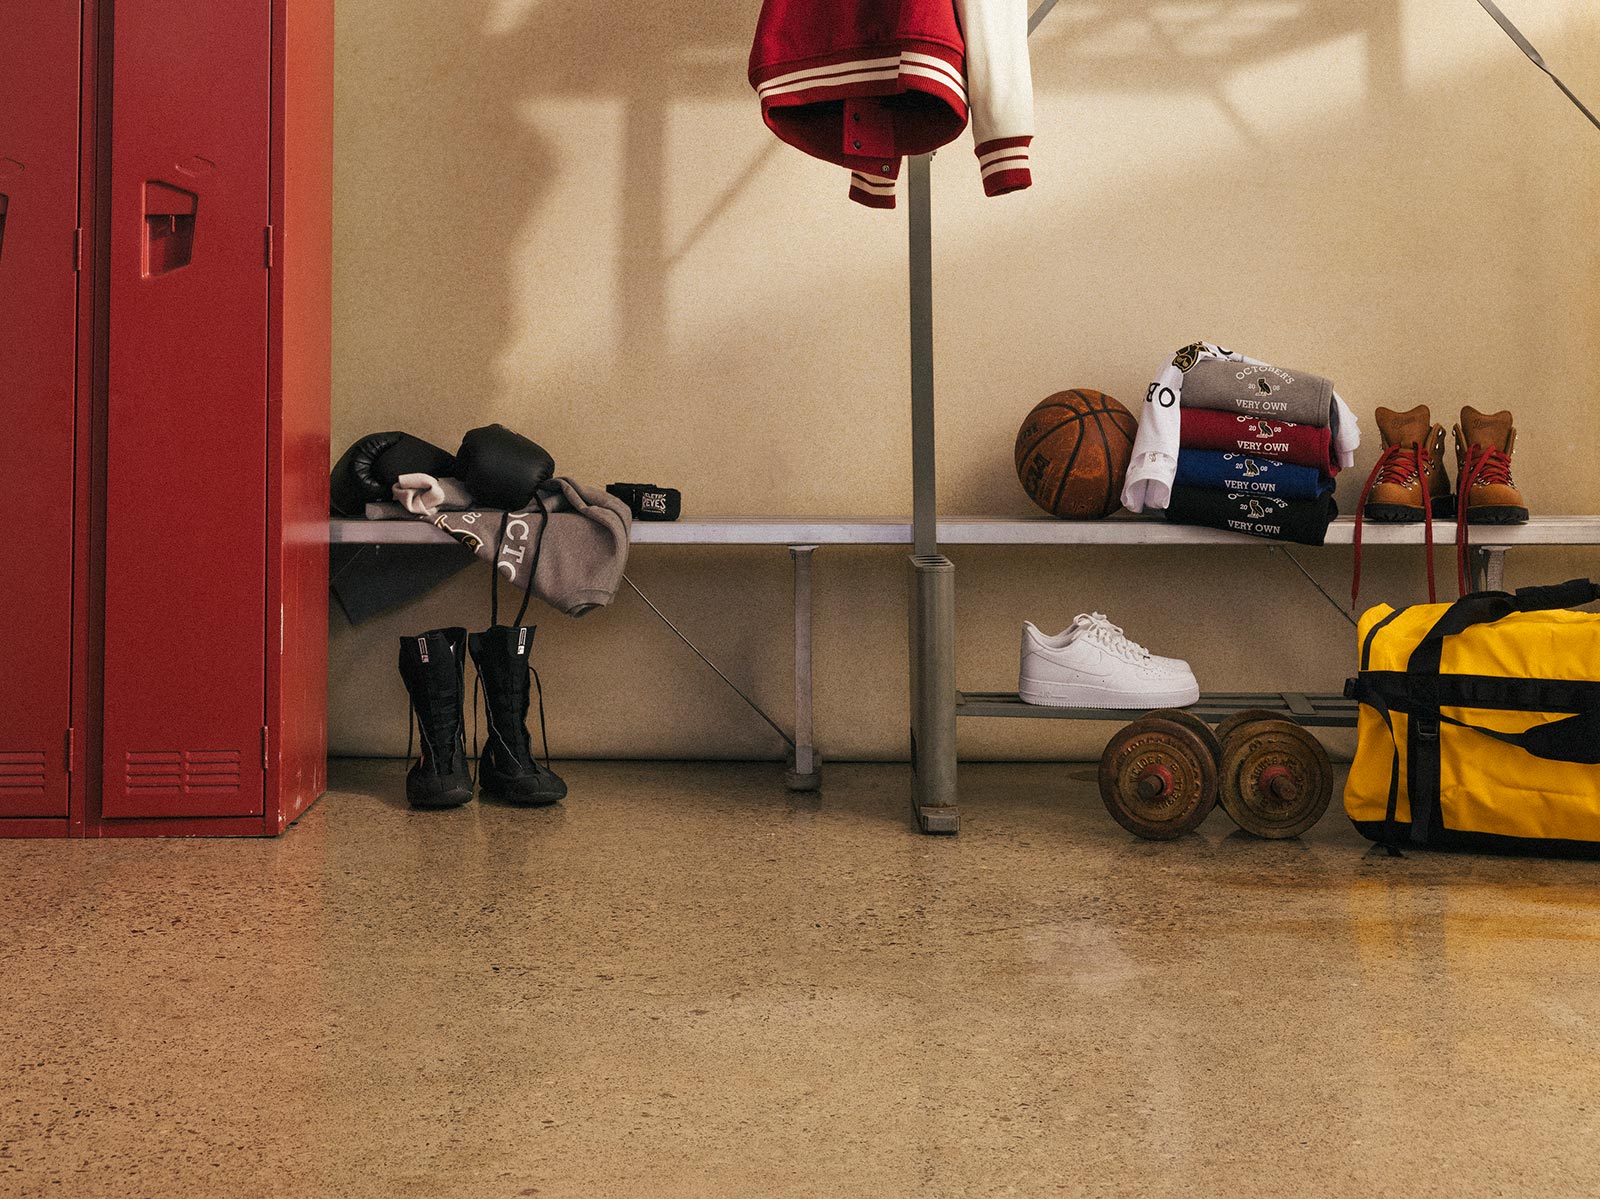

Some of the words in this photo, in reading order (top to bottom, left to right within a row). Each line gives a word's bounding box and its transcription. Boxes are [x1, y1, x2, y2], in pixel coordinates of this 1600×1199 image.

[1235, 398, 1260, 409] VERY
[1262, 401, 1288, 411] OWN
[1248, 424, 1257, 432] 20
[1236, 440, 1262, 450] VERY
[1263, 442, 1289, 452] OWN
[1235, 462, 1244, 470] 20
[1224, 479, 1249, 490] VERY
[1251, 482, 1276, 492] OWN
[641, 496, 666, 510] REYES
[1239, 503, 1248, 511] 20
[1227, 519, 1253, 531] VERY
[1255, 524, 1280, 534] OWN
